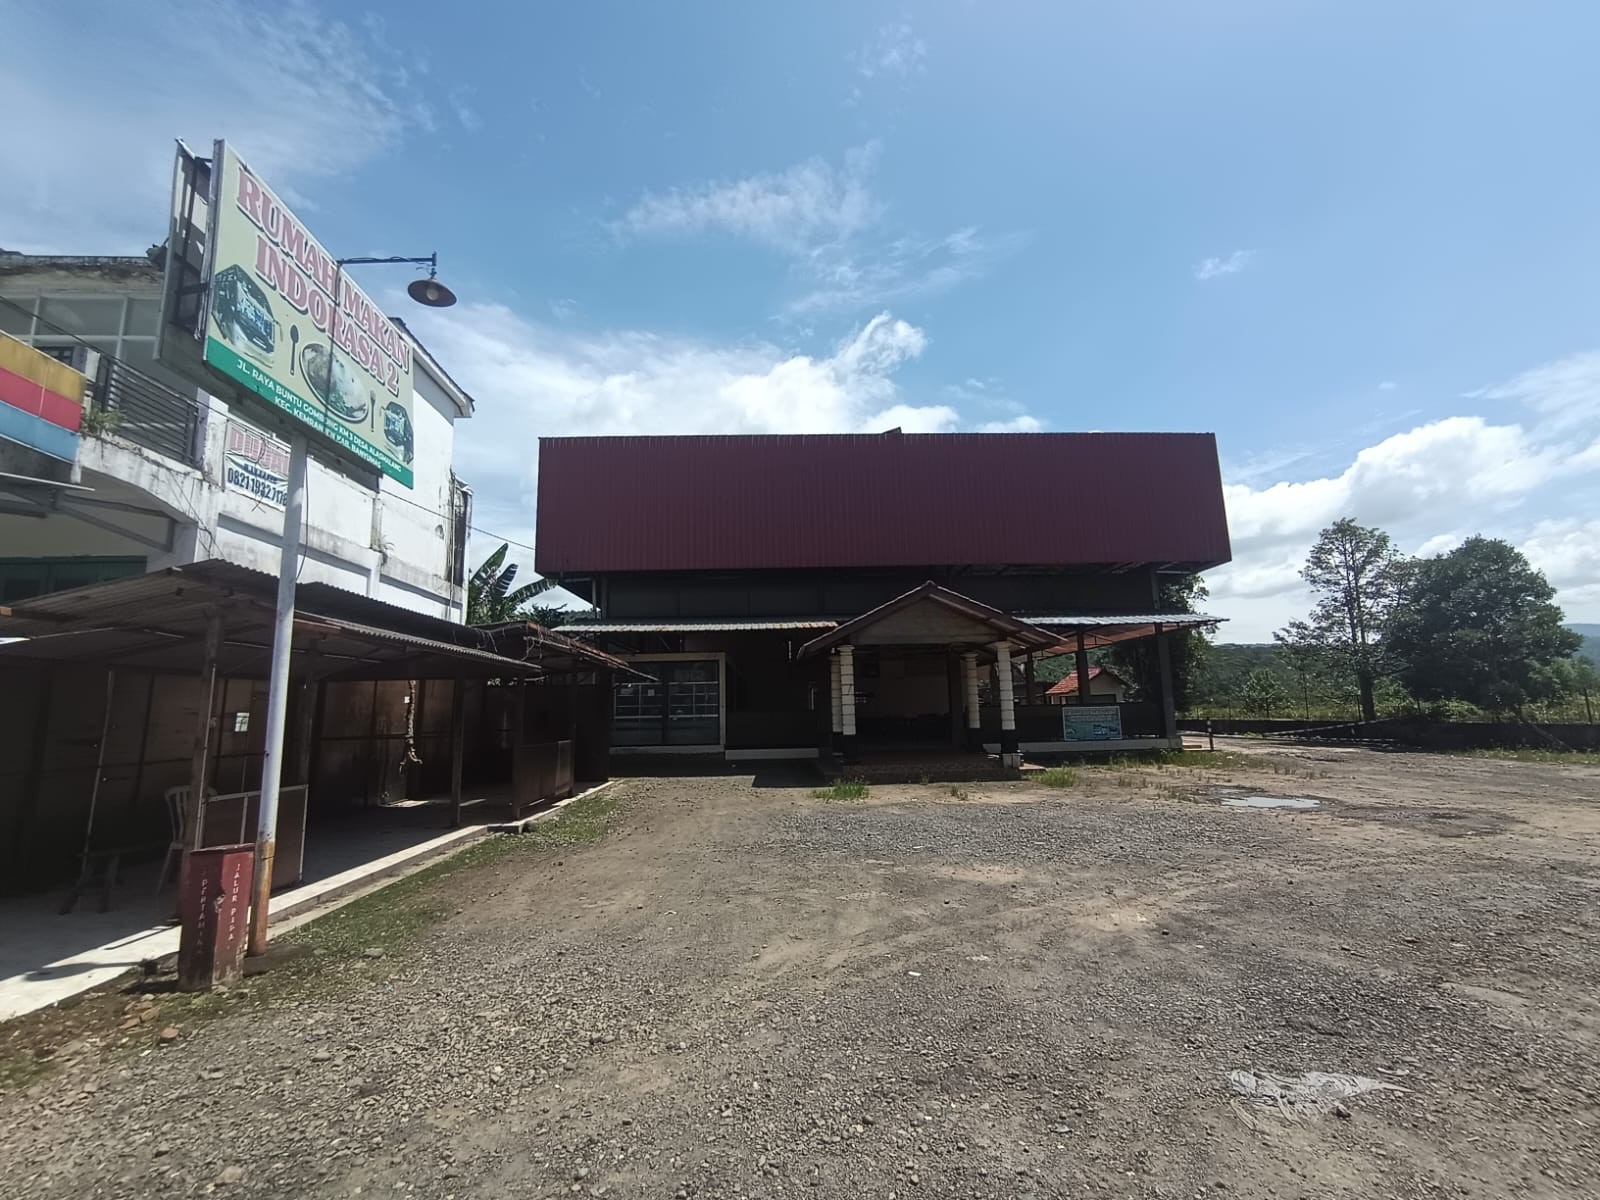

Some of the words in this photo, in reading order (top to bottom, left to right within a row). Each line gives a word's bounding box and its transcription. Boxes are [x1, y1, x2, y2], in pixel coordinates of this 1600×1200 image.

[237, 167, 339, 303] RUMAH
[343, 279, 409, 373] MAKAN
[237, 359, 250, 374] JL.
[252, 369, 275, 390] RAYA
[275, 385, 302, 407] BUNTU
[353, 434, 369, 450] DESA
[386, 363, 399, 396] 2
[274, 396, 292, 414] KEC.
[351, 444, 382, 469] BANYUMAS
[231, 863, 241, 903] JALUR
[228, 908, 237, 941] PIPA
